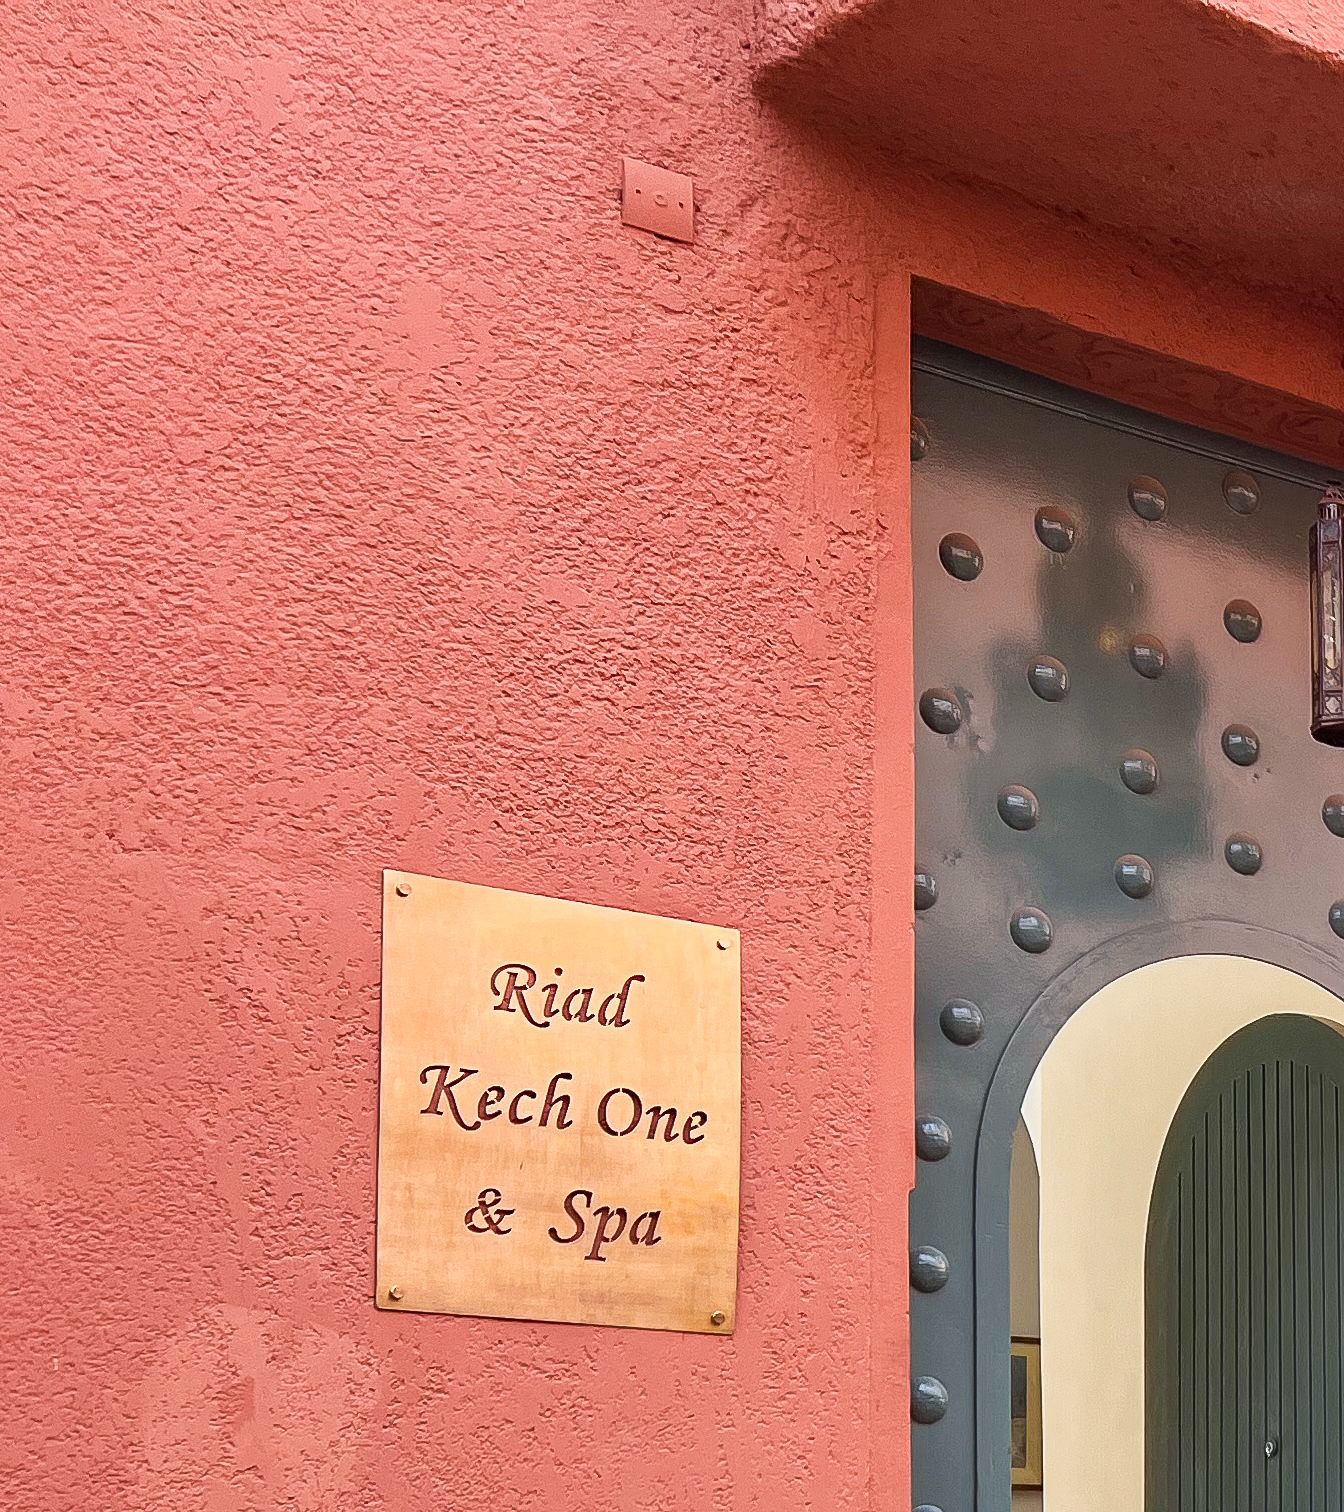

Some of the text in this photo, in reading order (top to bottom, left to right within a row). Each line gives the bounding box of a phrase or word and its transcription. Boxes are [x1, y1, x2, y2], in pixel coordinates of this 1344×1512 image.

[490, 963, 645, 1029] Riad
[419, 1065, 708, 1145] Kech One
[464, 1188, 662, 1262] & Spa
